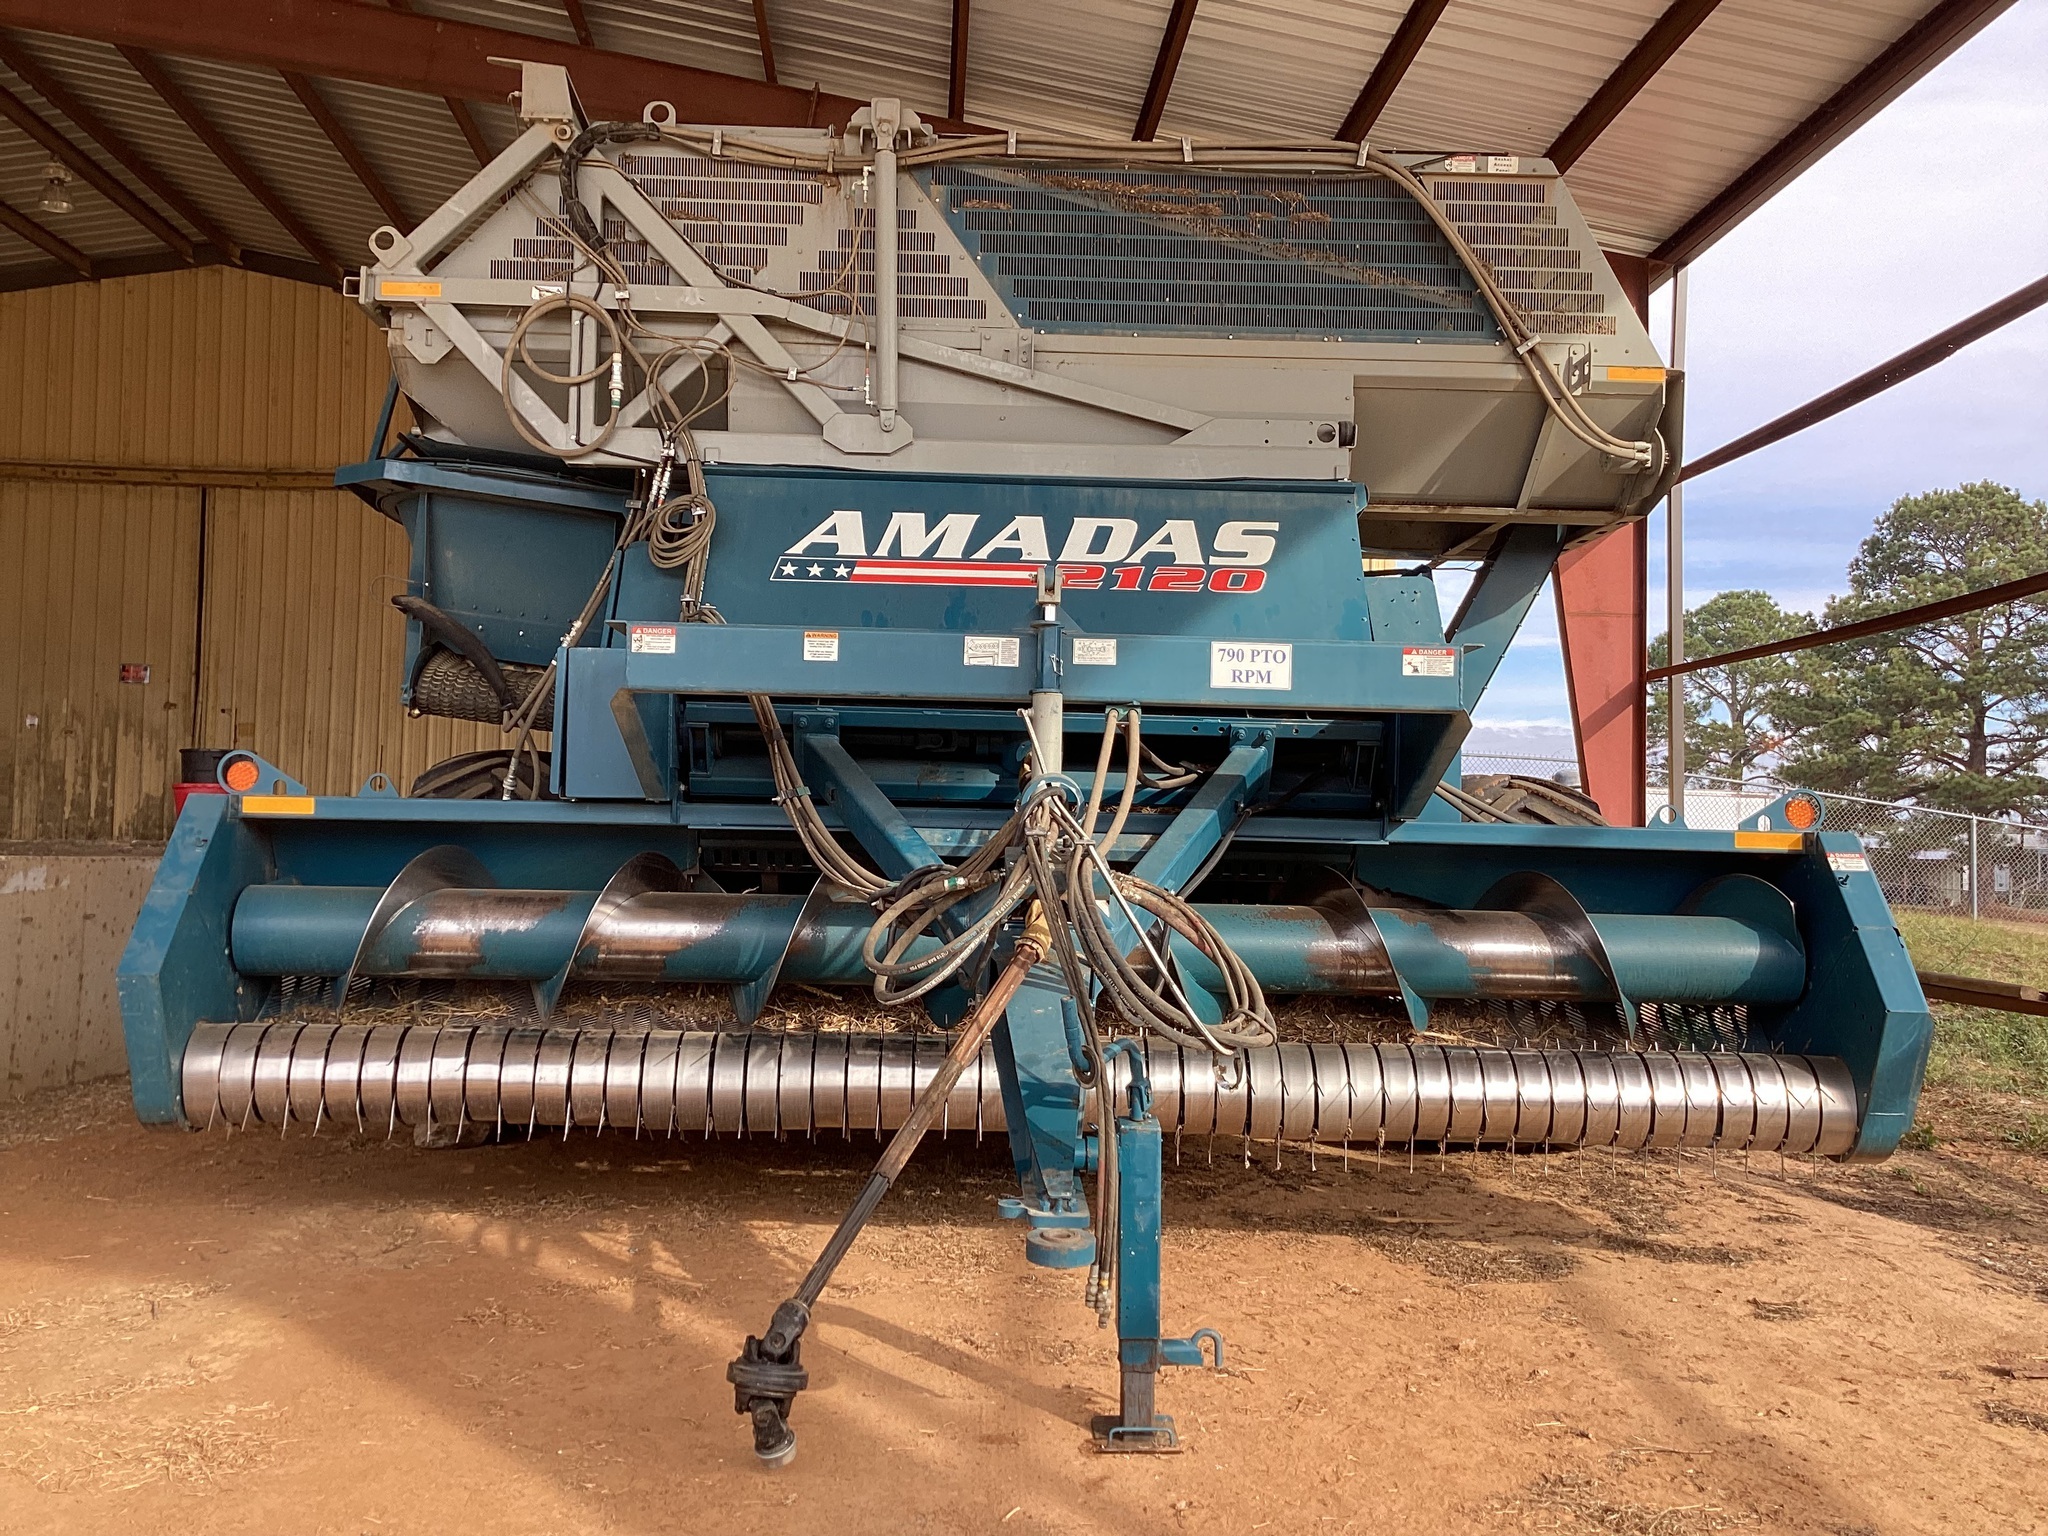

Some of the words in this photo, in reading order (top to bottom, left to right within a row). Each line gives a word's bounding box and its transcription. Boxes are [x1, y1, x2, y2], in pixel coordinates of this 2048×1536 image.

[784, 510, 1280, 566] AMADAS
[1055, 563, 1267, 593] 2120
[643, 627, 672, 635] DANGER
[1218, 648, 1245, 663] 790
[1250, 648, 1287, 664] PTO
[1231, 668, 1272, 685] RPM
